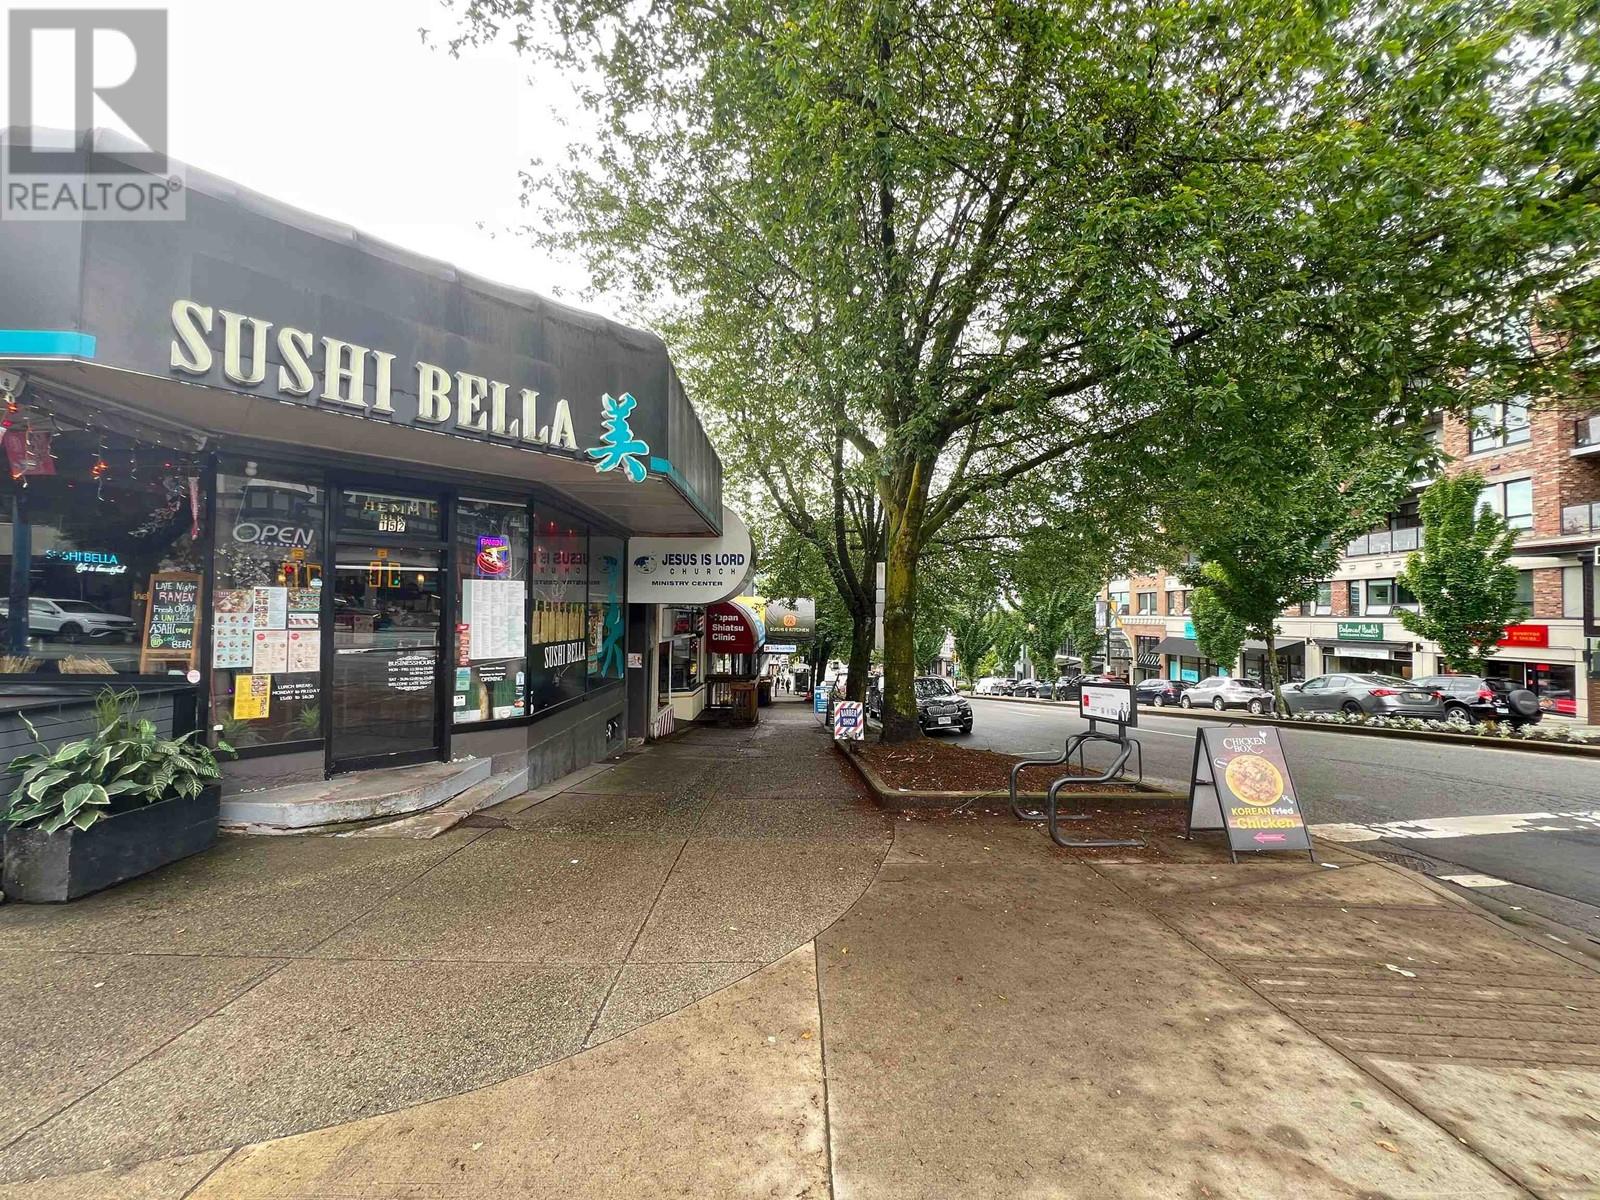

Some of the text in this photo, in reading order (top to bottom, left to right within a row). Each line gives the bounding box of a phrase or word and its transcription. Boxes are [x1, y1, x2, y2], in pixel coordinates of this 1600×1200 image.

[170, 299, 579, 451] SUSHI BELLA
[586, 392, 650, 484] 美
[379, 520, 405, 532] 152
[232, 523, 314, 545] OPEN
[46, 549, 118, 564] SSHI BELLA
[661, 553, 745, 566] JESUS IS LORD
[669, 567, 736, 575] CHURCH
[155, 582, 173, 591] LATE
[159, 591, 195, 603] RAMEN
[153, 604, 174, 613] Fresh
[161, 614, 175, 622] UNI
[712, 613, 739, 624] apan
[149, 623, 176, 635] ASAHI
[712, 624, 744, 633] Shiatsu
[712, 633, 736, 641] Clinic
[171, 640, 193, 648] BEER
[544, 641, 586, 669] SUSHI BELLA
[840, 709, 857, 717] BARBER
[842, 718, 856, 726] SHOP
[1223, 737, 1267, 750] CHICKEN
[1234, 745, 1258, 754] BOX
[1231, 807, 1294, 816] KOREAN Fried
[1237, 817, 1297, 829] Chicken
